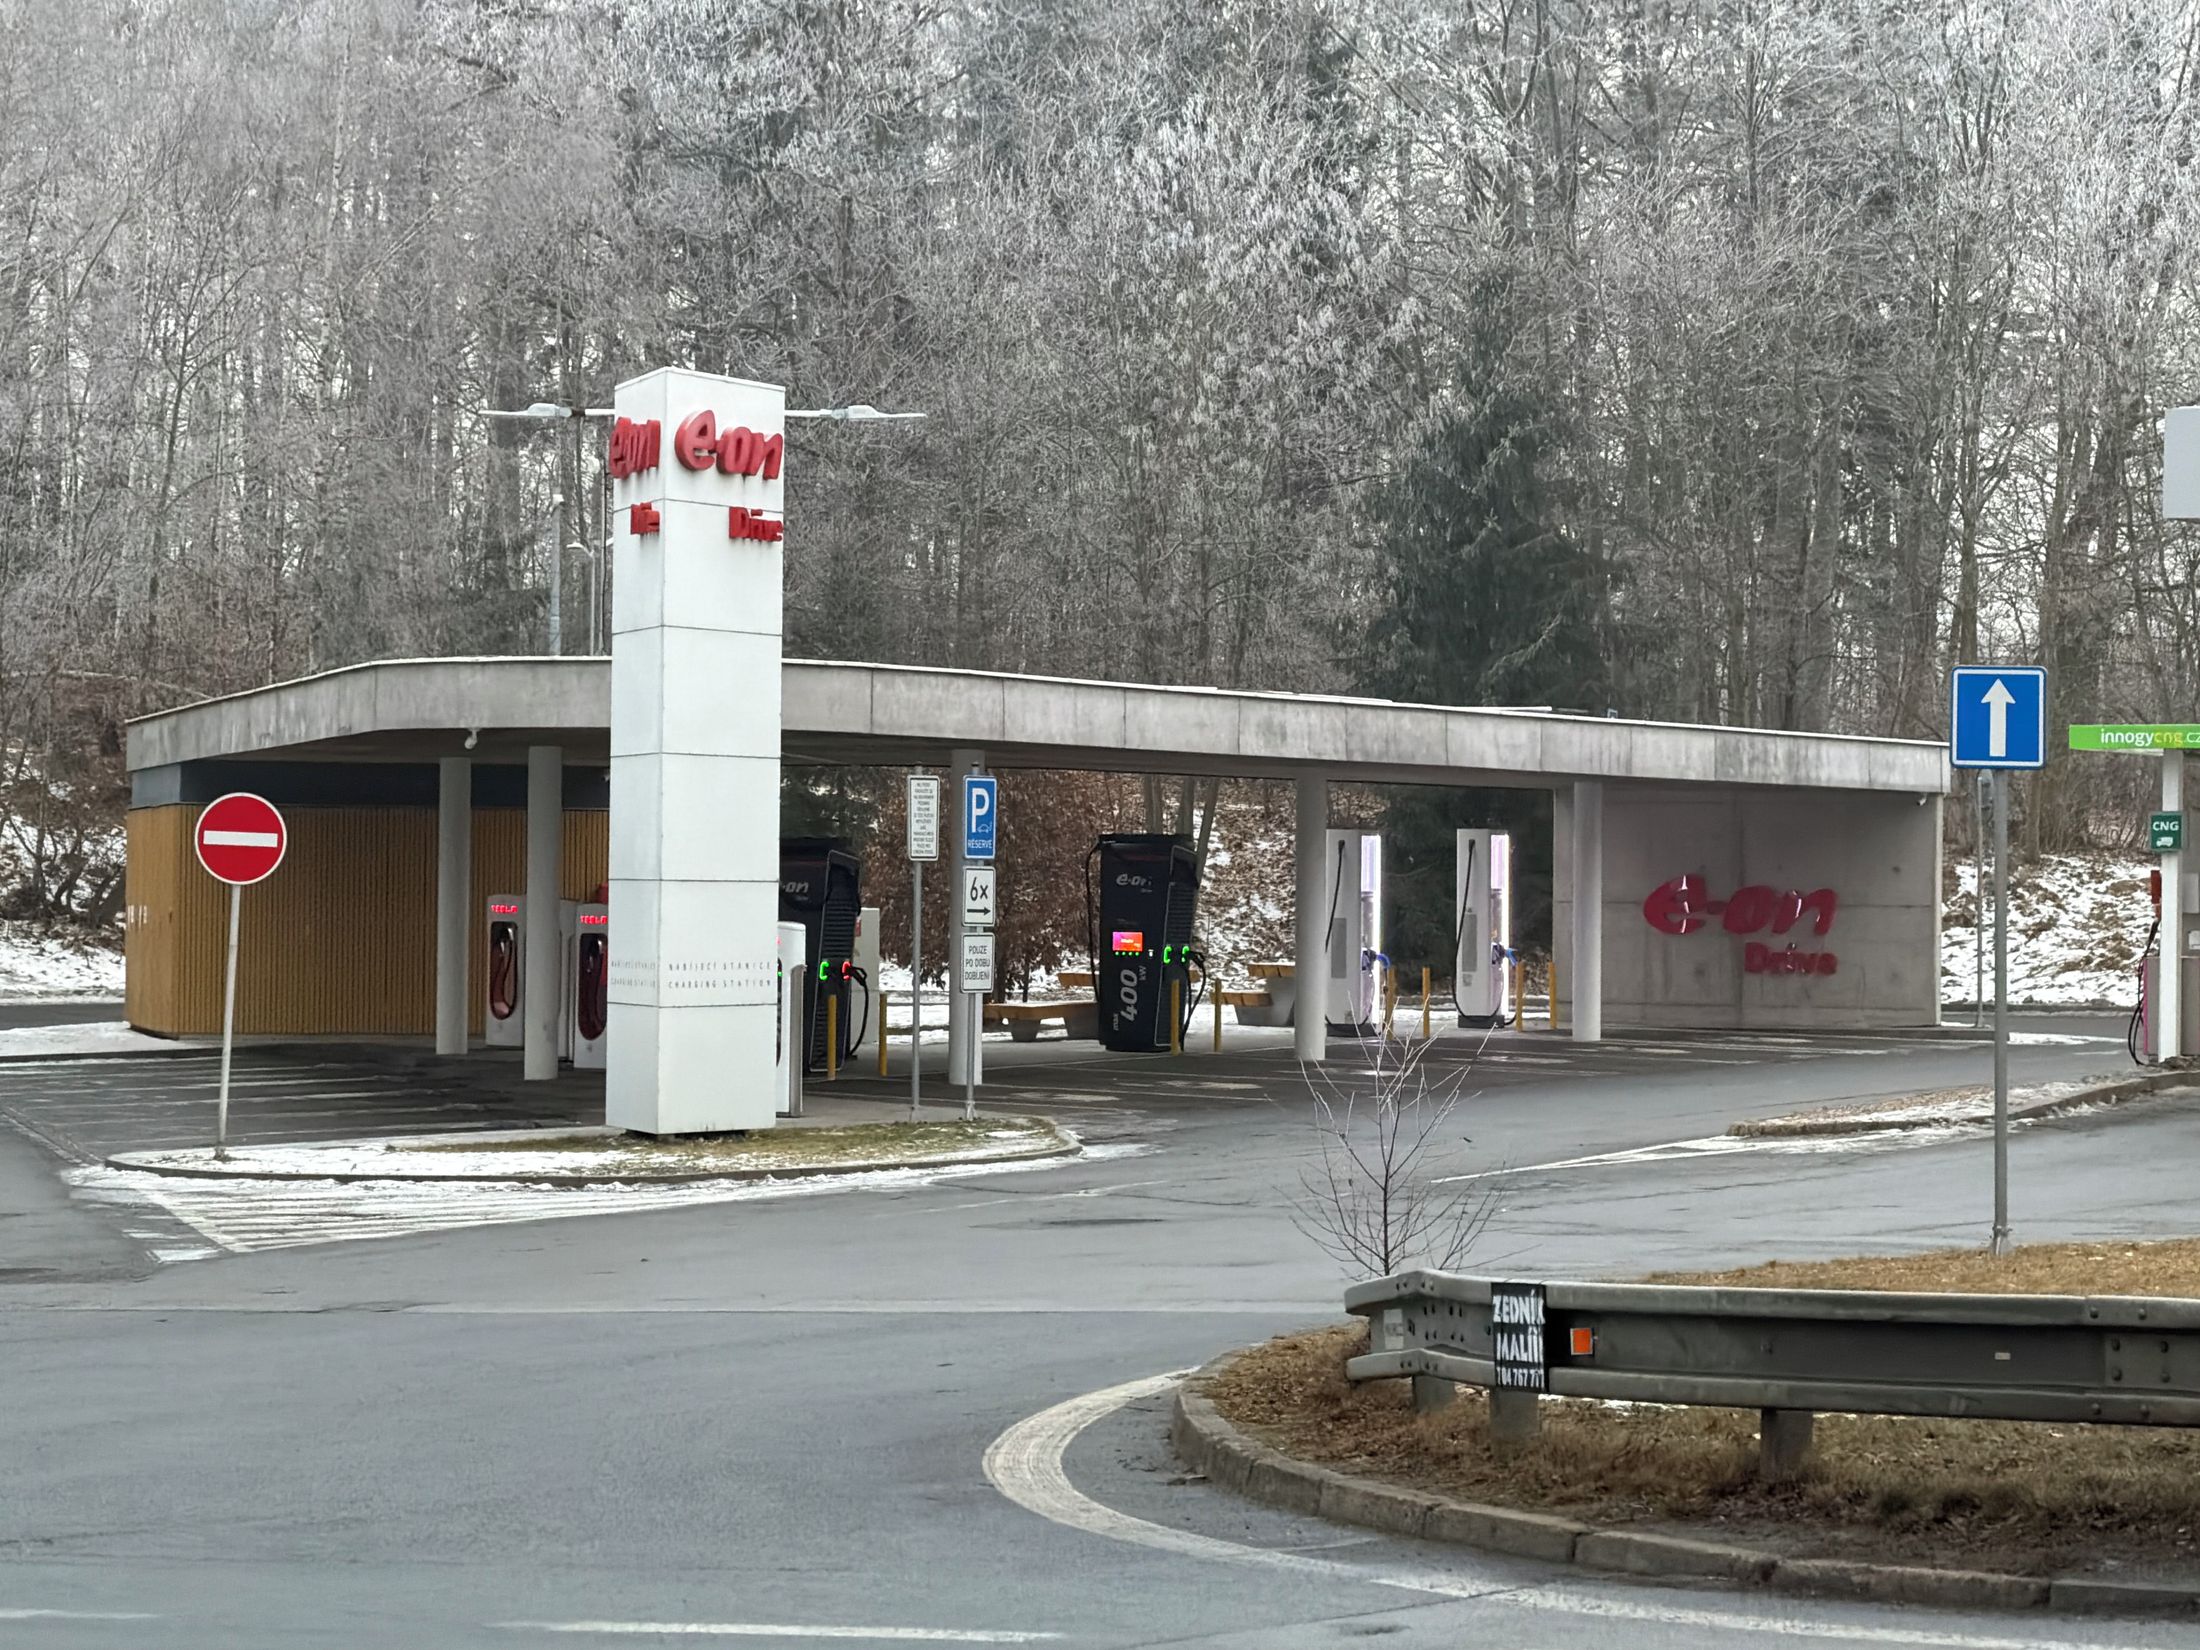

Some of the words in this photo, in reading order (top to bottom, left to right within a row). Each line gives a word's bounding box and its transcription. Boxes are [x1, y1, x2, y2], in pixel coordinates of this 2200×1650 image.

[729, 506, 783, 542] Drive
[2100, 728, 2200, 747] innogycng.cz
[971, 787, 990, 833] P
[2152, 821, 2179, 832] CNG
[965, 958, 974, 967] PO
[968, 945, 988, 954] POUZE
[1744, 942, 1838, 976] Drive
[1120, 969, 1138, 1022] 400
